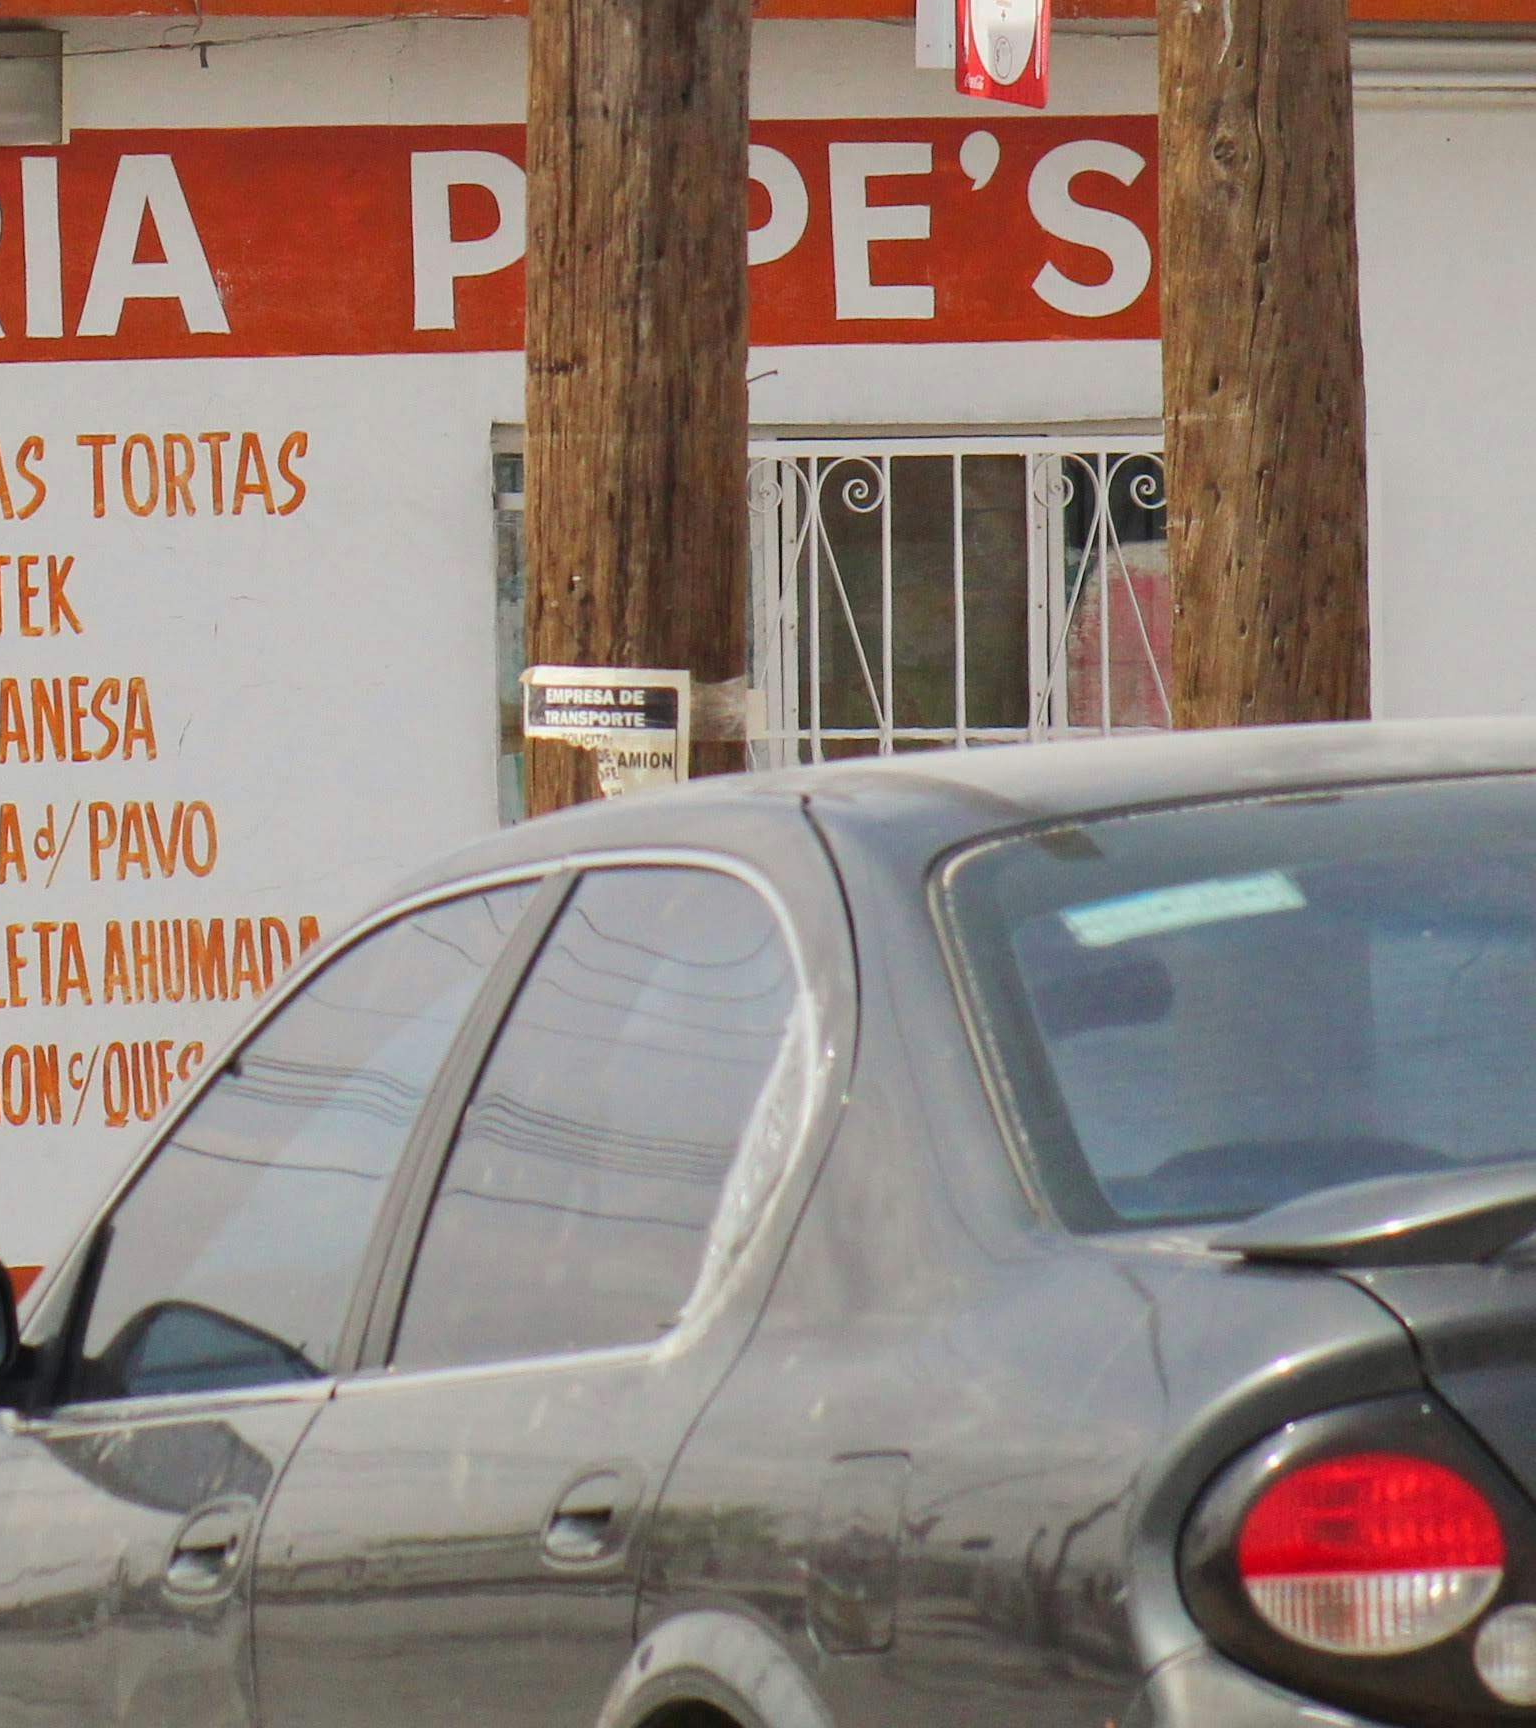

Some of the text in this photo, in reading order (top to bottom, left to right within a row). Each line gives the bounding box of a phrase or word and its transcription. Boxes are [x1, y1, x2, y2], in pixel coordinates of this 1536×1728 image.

[410, 130, 1153, 332] PE'S
[75, 430, 310, 518] TORTAS
[544, 709, 647, 727] TRANSPORTE
[545, 687, 646, 706] EMPRESA DE
